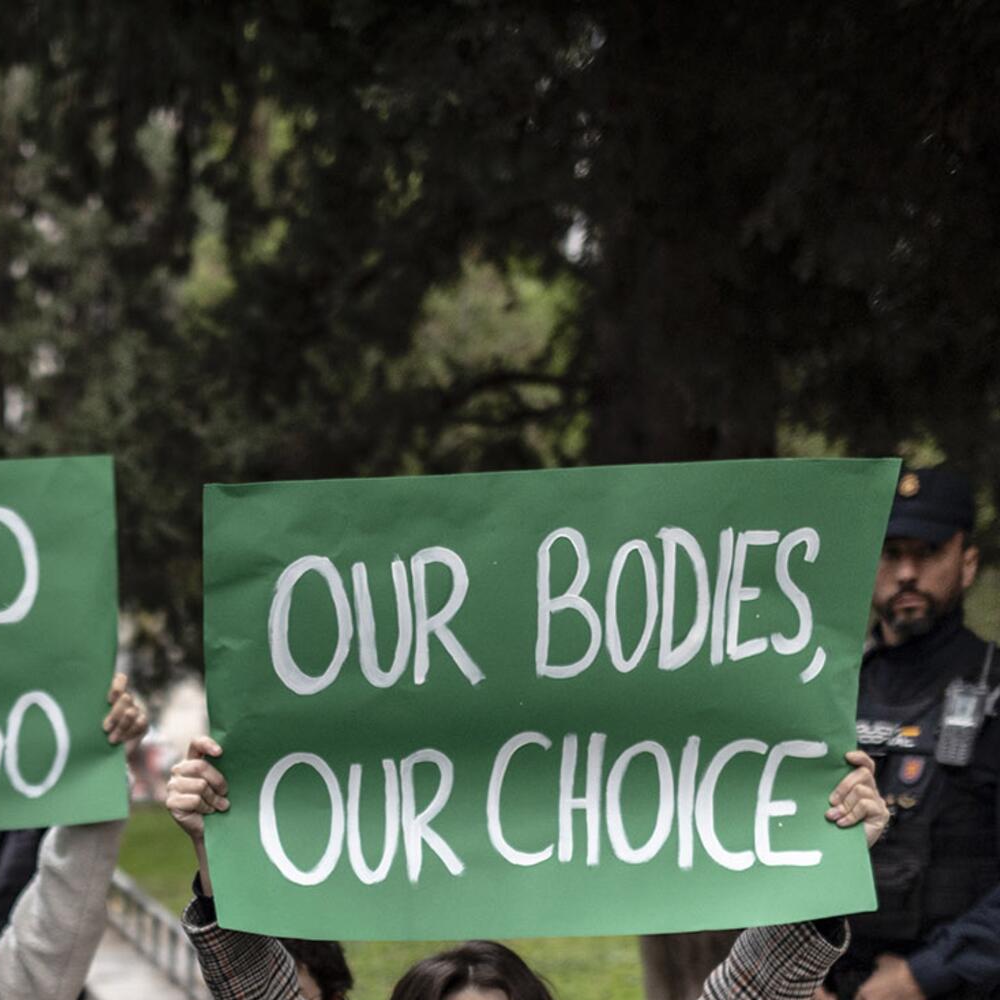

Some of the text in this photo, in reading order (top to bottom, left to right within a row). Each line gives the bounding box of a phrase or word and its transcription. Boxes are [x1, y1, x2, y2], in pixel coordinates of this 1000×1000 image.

[267, 526, 827, 695] OUR BODIES,
[259, 730, 829, 886] OUR CHOICE
